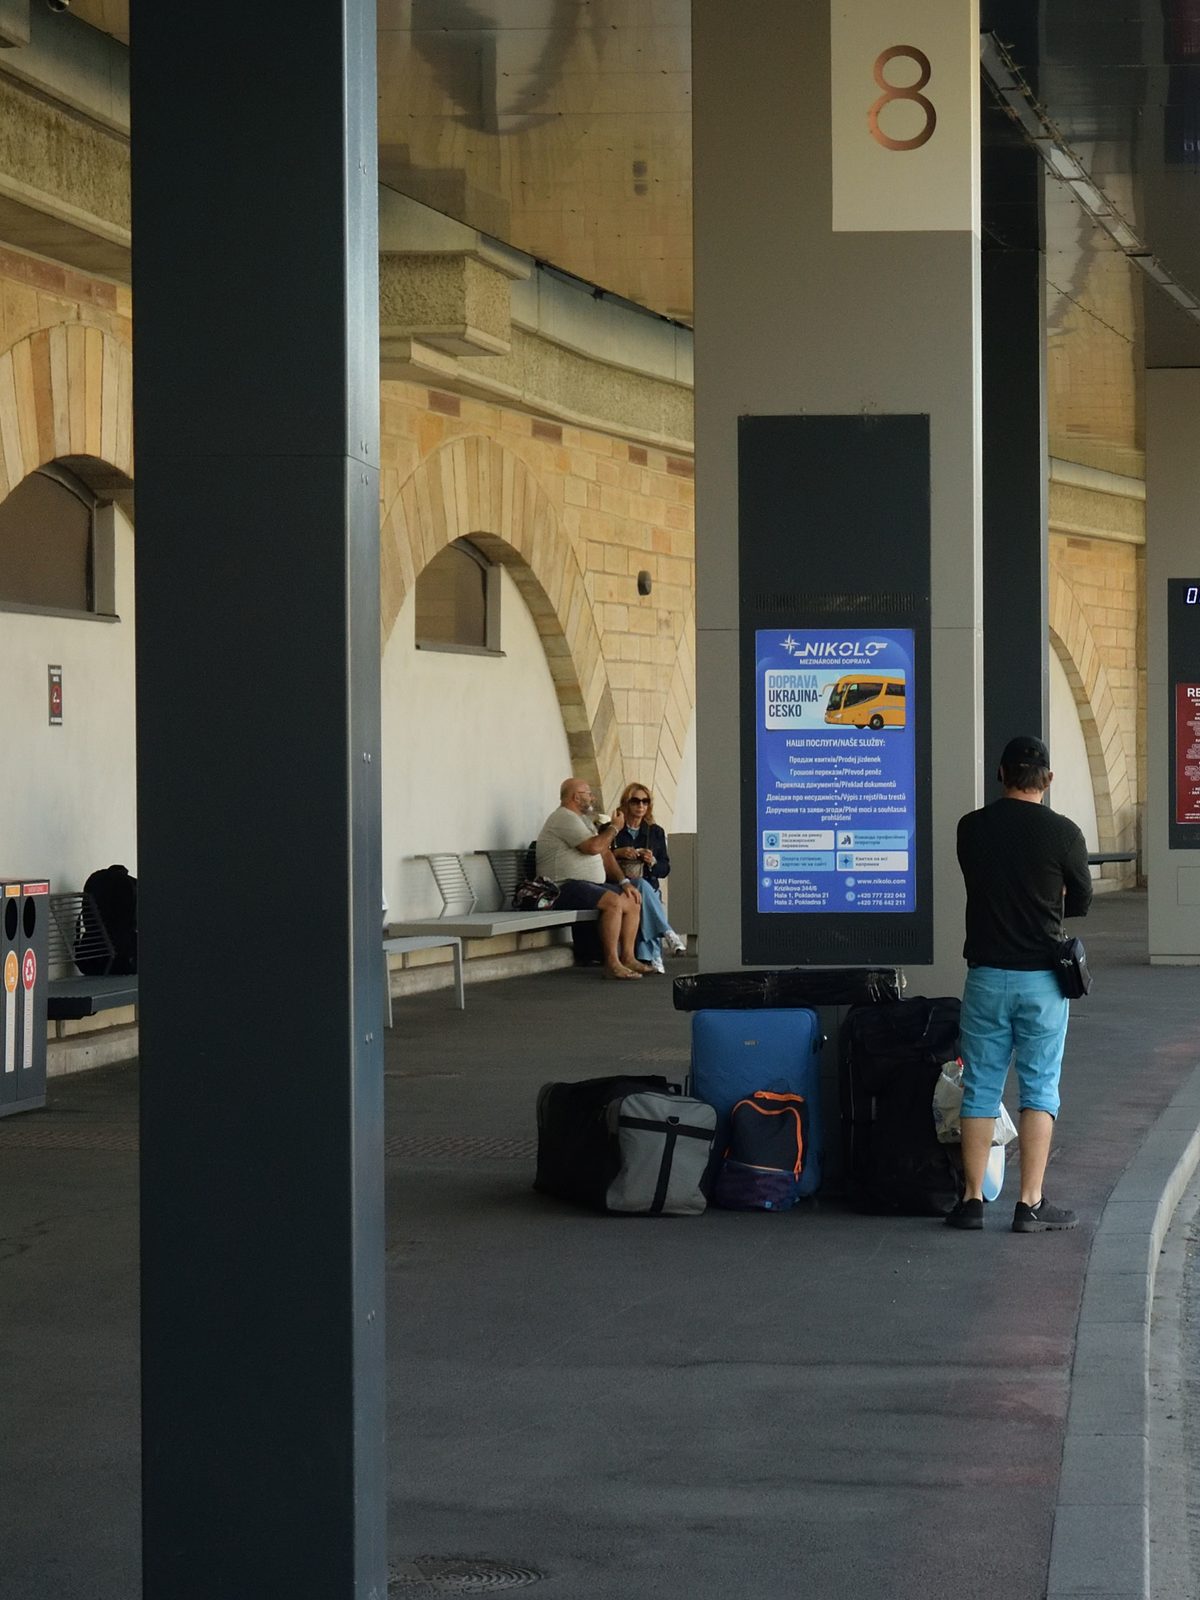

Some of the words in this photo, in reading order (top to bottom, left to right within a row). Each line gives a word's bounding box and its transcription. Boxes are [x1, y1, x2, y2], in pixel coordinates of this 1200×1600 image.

[868, 45, 937, 151] 8
[795, 642, 888, 656] NIKOLO
[769, 675, 818, 688] DOPRAVA
[769, 690, 822, 703] UKRAJINA-
[786, 739, 804, 747] НАШІ
